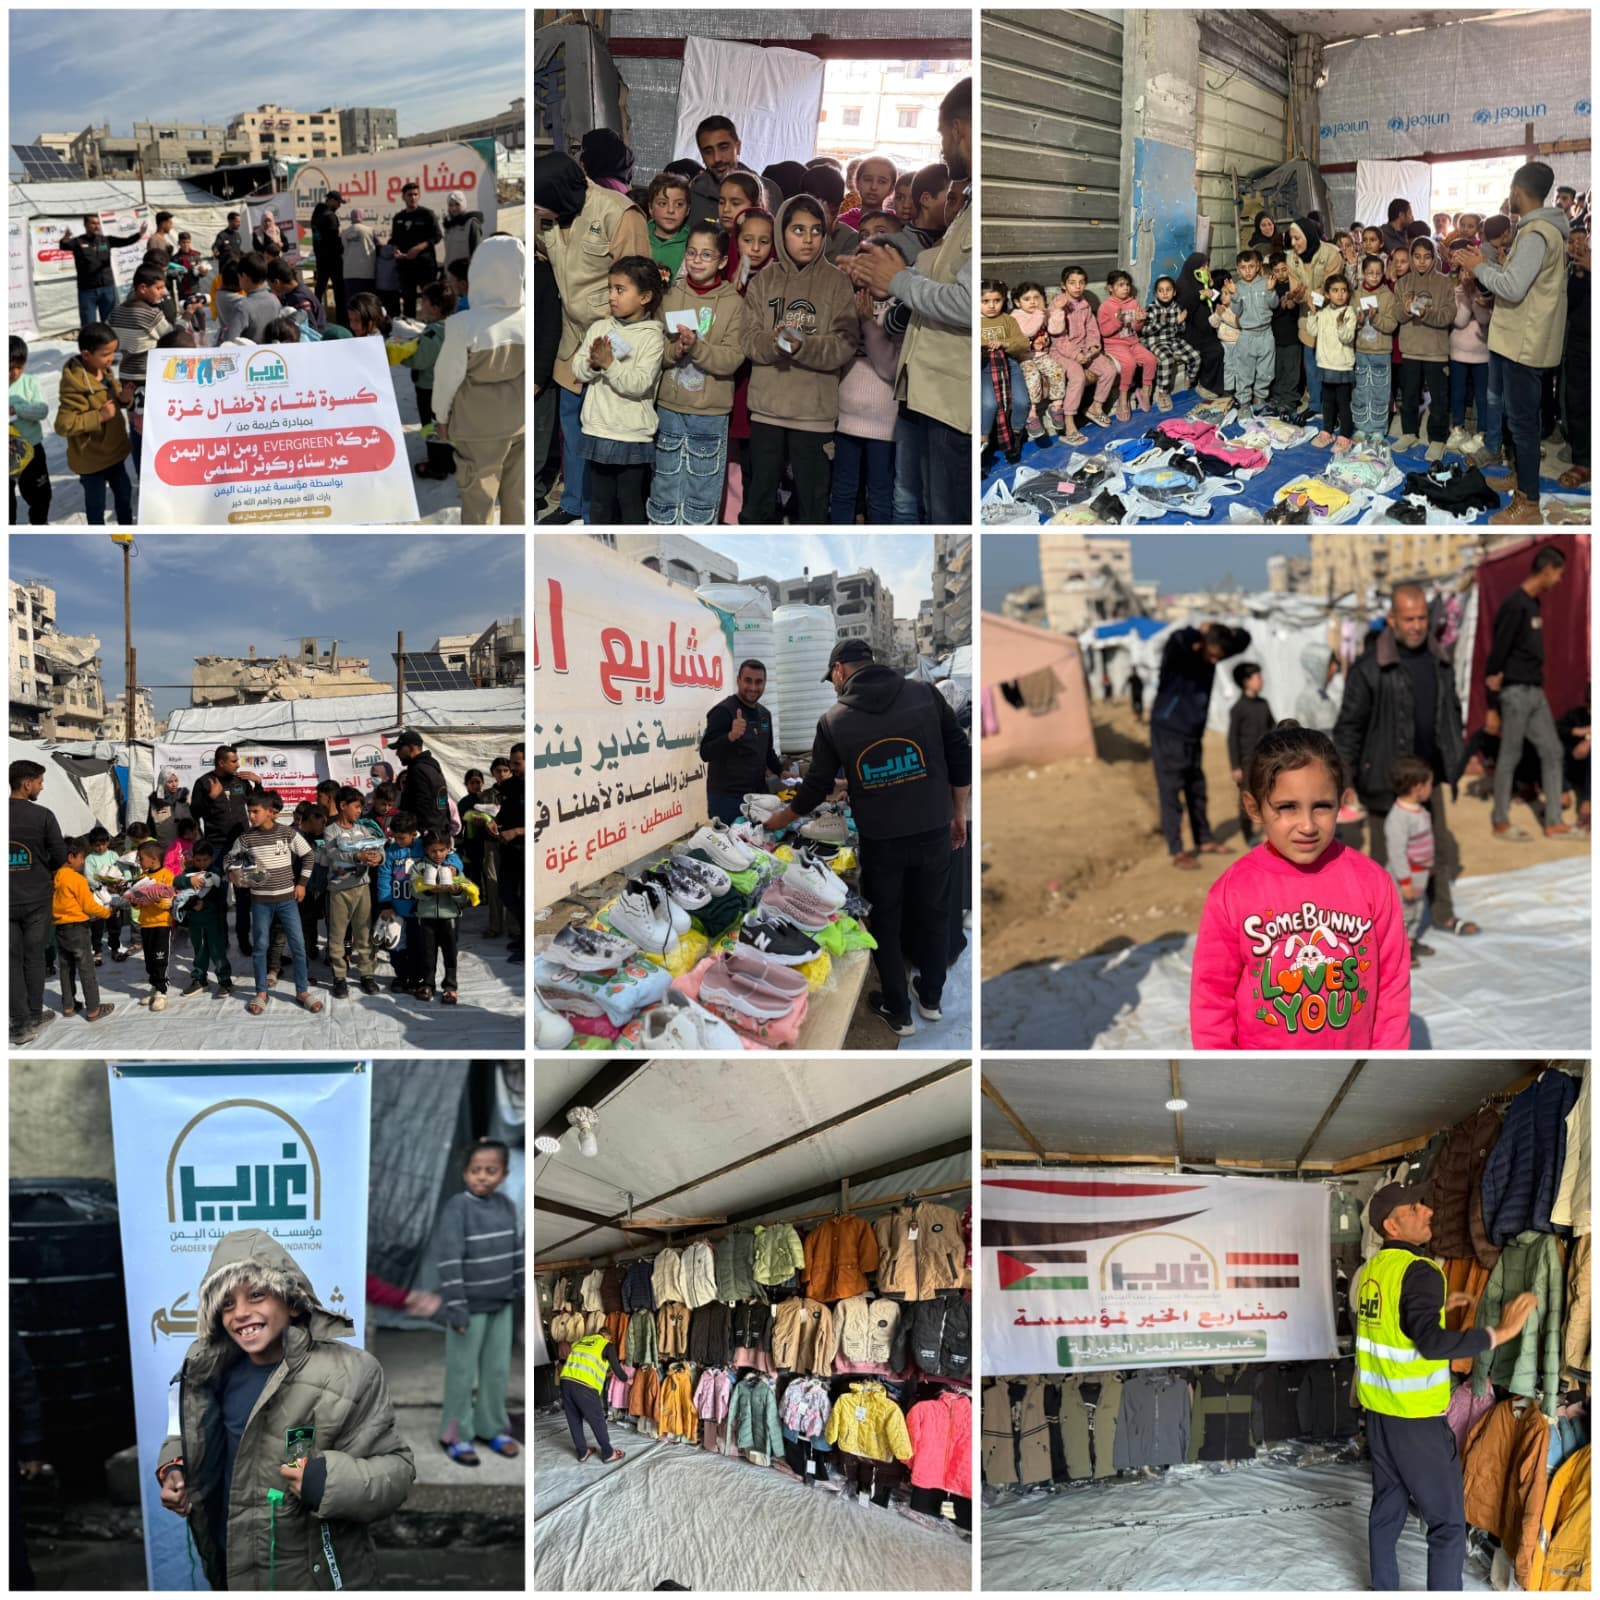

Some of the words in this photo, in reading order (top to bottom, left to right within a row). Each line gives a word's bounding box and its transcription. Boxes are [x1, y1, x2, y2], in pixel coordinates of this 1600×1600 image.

[1406, 111, 1451, 132] unicef
[1495, 103, 1548, 125] unicef
[1334, 120, 1369, 138] unicef
[249, 359, 284, 382] غدير
[207, 391, 267, 420] لأطفال
[270, 390, 317, 413] شتاء
[319, 386, 379, 411] كسوة
[167, 398, 204, 421] غزة
[236, 421, 250, 432] من
[251, 418, 280, 430] كريمة
[282, 417, 314, 428] بمبادرة
[263, 436, 334, 453] EVERGREEN
[336, 430, 381, 449] شركة
[169, 443, 205, 463] اليمن
[207, 442, 230, 461] أهل
[233, 443, 258, 459] ومن
[328, 451, 349, 467] عبر
[203, 459, 248, 483] السلمي
[251, 456, 295, 477] وكوثر
[296, 453, 326, 470] سناء
[214, 485, 235, 498] اليمن
[236, 485, 253, 495] بنت
[254, 482, 272, 495] غدير
[273, 480, 308, 492] مؤسسة
[309, 477, 343, 490] بواسطة
[600, 621, 724, 704] مشاريع
[591, 720, 650, 771] غدير
[652, 719, 704, 752] ؤسسة
[862, 746, 920, 781] غدير
[557, 781, 612, 823] لأهلنا
[640, 800, 683, 834] فلسطين
[585, 821, 627, 861] قطاع
[545, 840, 579, 874] غزة
[1260, 956, 1360, 1000] LOVES
[1273, 990, 1353, 1033] YOU
[180, 1142, 307, 1222] غدير
[169, 1227, 206, 1241] اليمن
[272, 1225, 322, 1240] مؤسسة
[170, 1243, 208, 1253] GHADEER
[281, 1242, 322, 1251] UNDATION
[1111, 1253, 1209, 1291] غدير
[1013, 1308, 1129, 1328] لمؤسسة
[1136, 1307, 1189, 1328] الخير
[1197, 1302, 1288, 1328] مشاريع
[1068, 1340, 1134, 1358] الخيرية
[1135, 1340, 1179, 1356] اليمن
[1183, 1339, 1211, 1354] بنت
[1214, 1337, 1257, 1352] غدير
